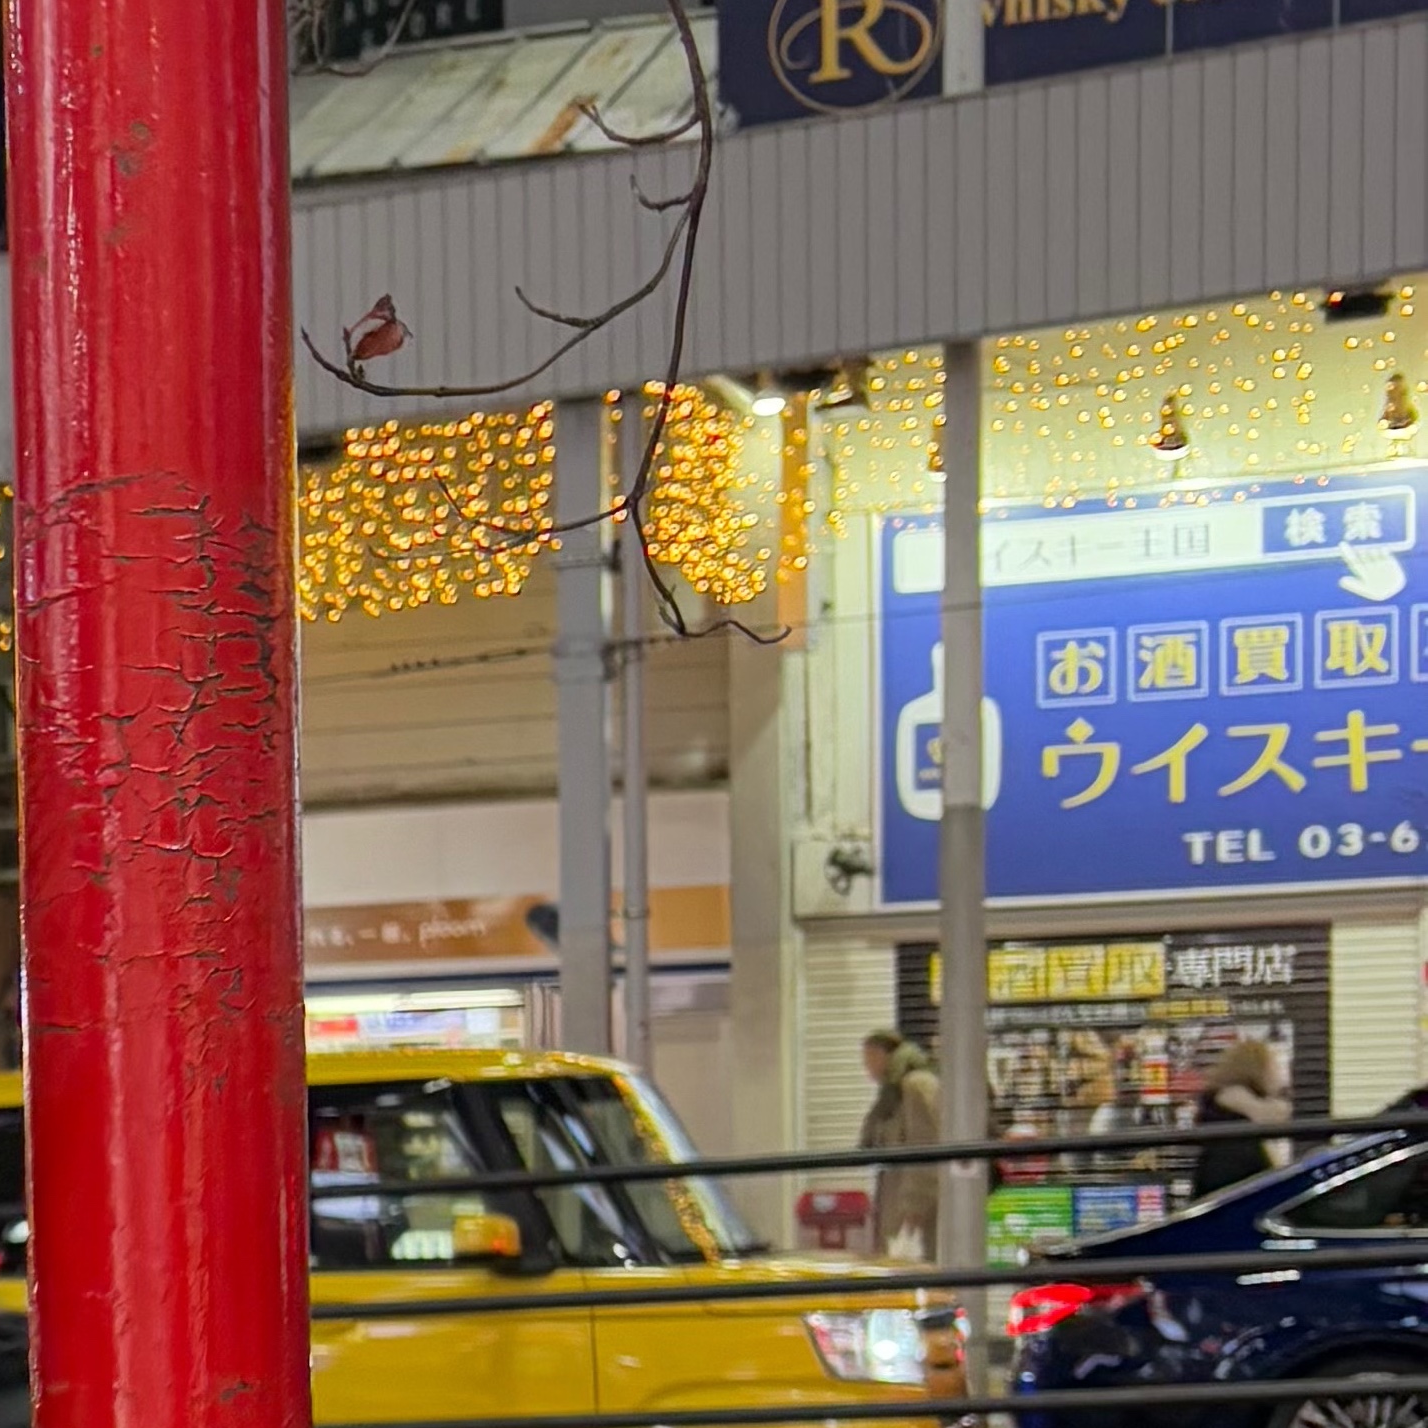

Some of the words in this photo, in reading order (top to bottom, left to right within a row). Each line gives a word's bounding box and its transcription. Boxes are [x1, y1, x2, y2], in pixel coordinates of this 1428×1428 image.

[991, 521, 1211, 575] イスキー王国
[1284, 501, 1385, 547] 検索
[1048, 618, 1428, 696] お酒買取
[1041, 709, 1428, 810] ウイスキ
[1183, 829, 1277, 867] TEL
[1298, 820, 1428, 860] 03-6
